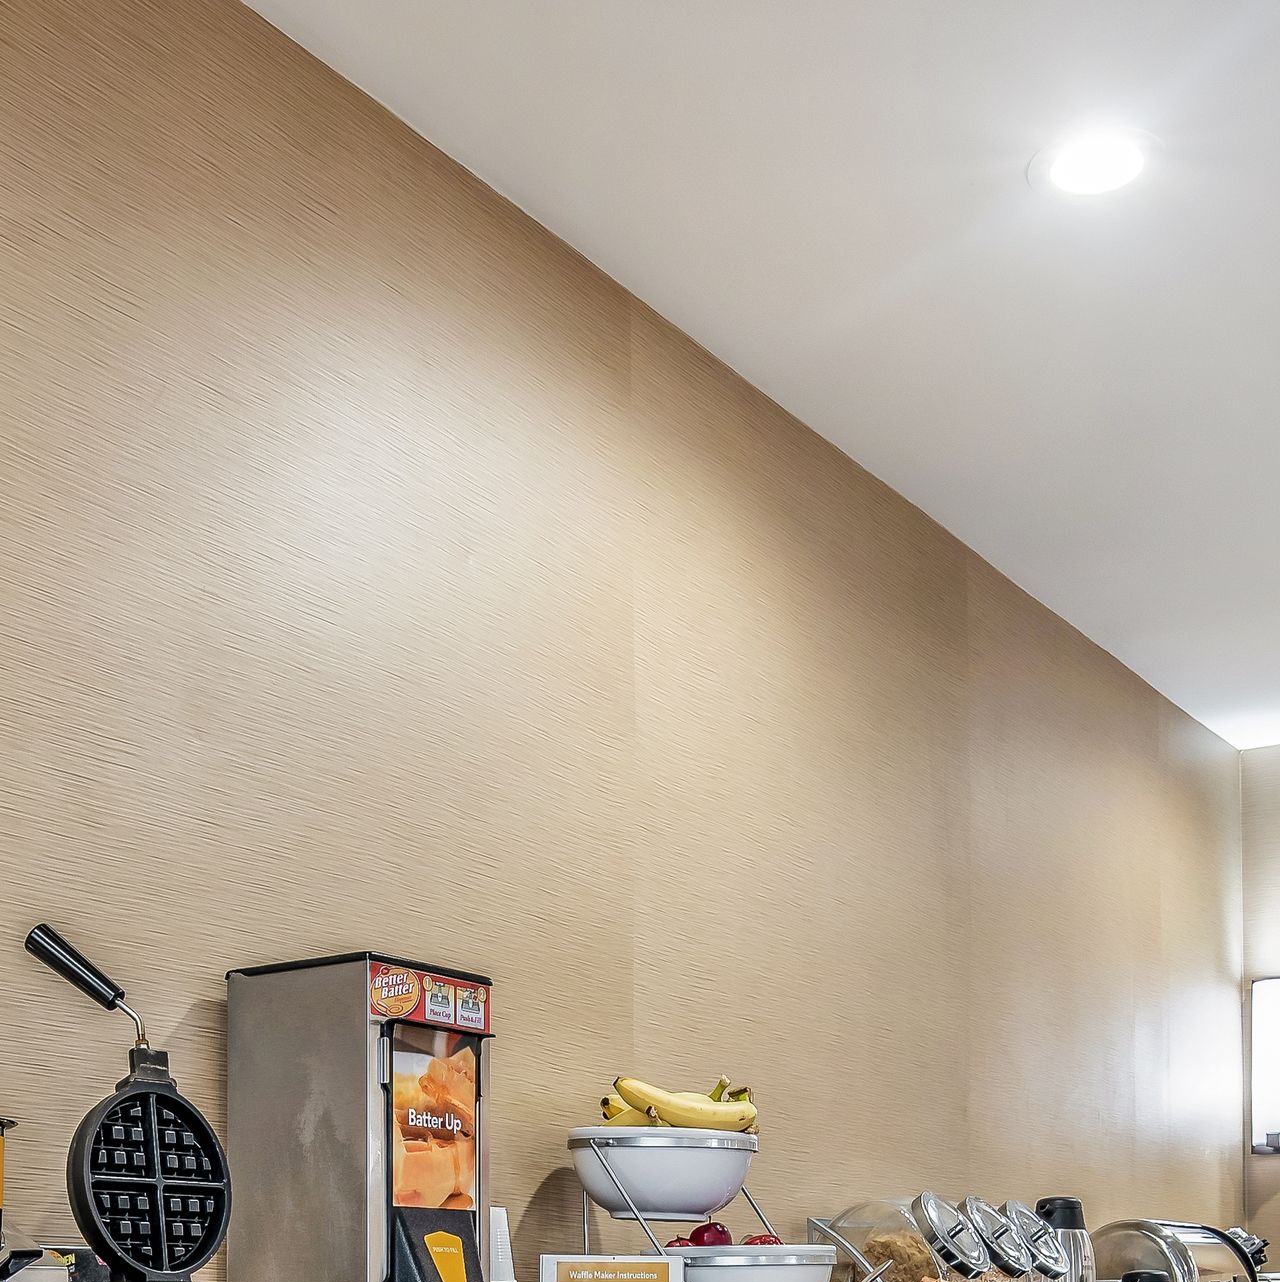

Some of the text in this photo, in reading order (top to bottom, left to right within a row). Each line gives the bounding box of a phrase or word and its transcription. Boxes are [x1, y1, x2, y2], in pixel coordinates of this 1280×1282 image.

[374, 972, 409, 989] Better
[381, 982, 415, 1000] Batter
[429, 1008, 452, 1020] Place Cup
[408, 1108, 462, 1135] Batter Up
[569, 1270, 658, 1280] Waffle Maker Instructions
